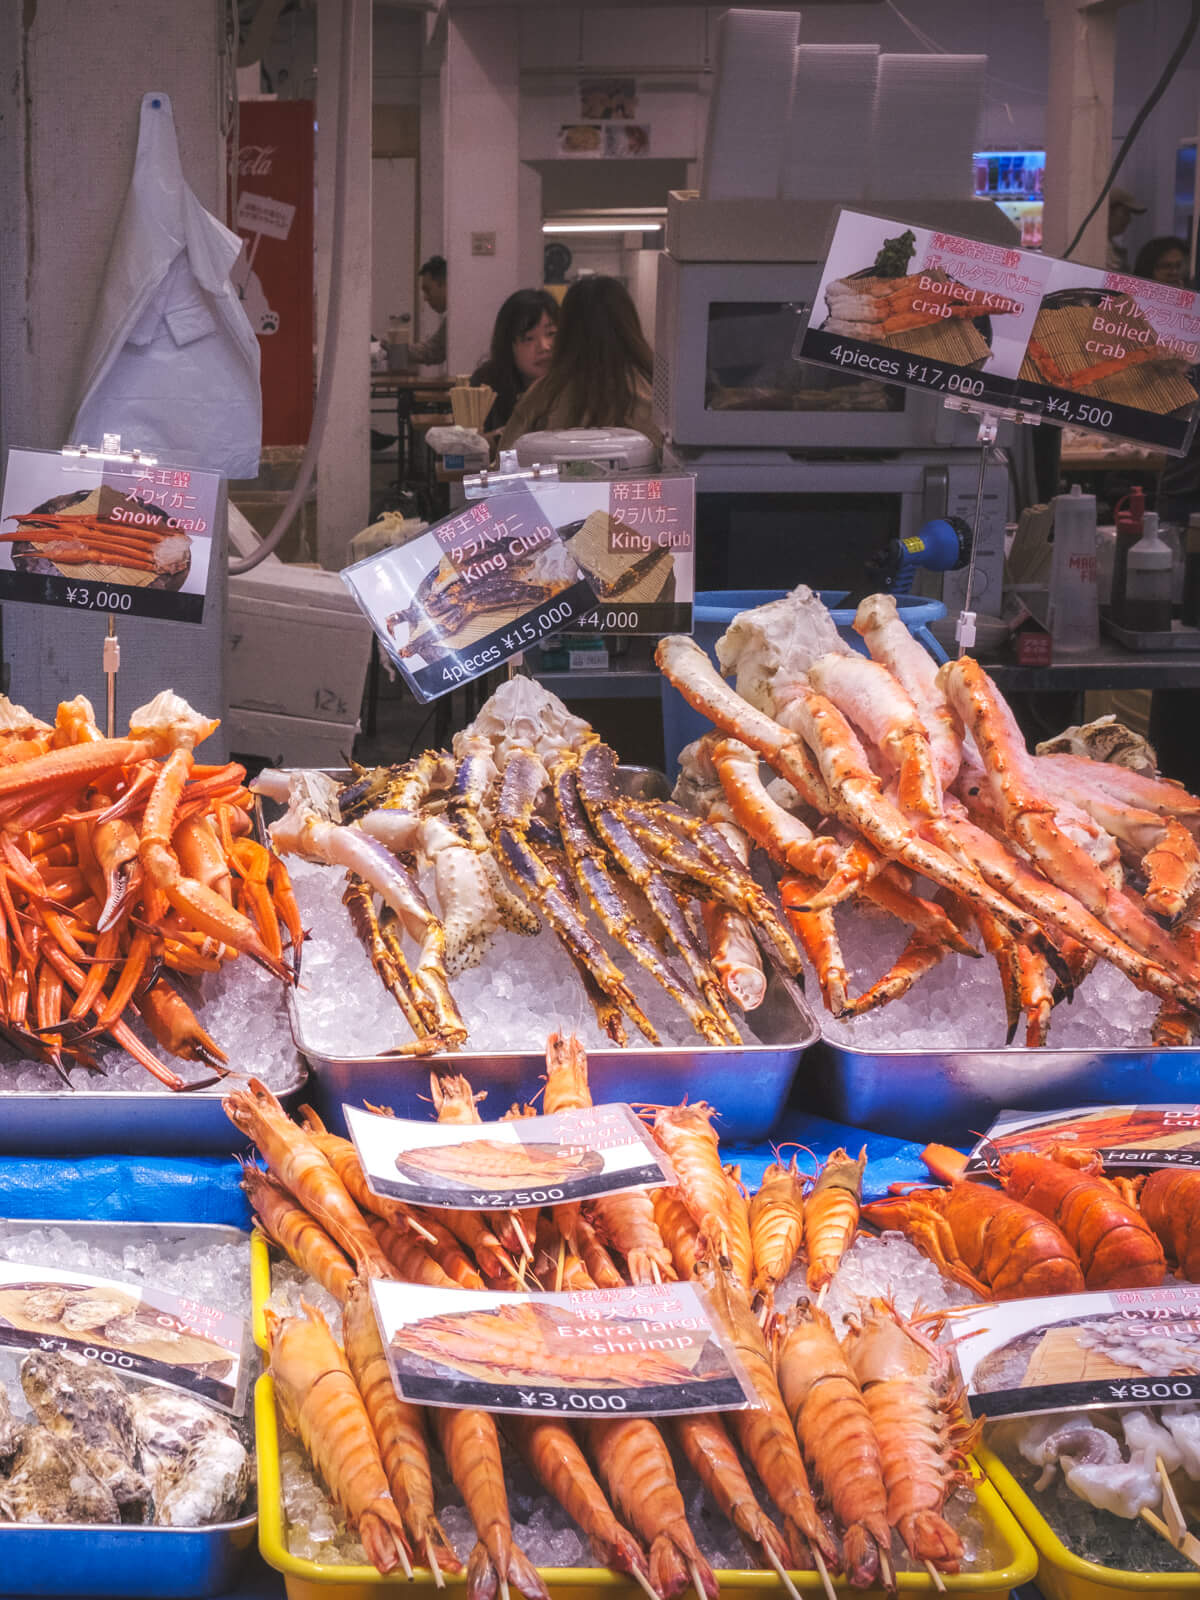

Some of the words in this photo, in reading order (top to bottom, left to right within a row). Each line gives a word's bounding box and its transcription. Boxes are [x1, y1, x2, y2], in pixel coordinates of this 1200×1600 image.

[919, 276, 977, 303] Boiled
[982, 292, 1024, 317] King
[912, 299, 953, 319] crab
[1092, 316, 1151, 344] Boiled
[1156, 334, 1197, 358] King
[1085, 340, 1126, 359] crab
[830, 344, 899, 375] 4pieces
[906, 361, 985, 397] ¥17,000
[1046, 395, 1113, 427] ¥4,500
[612, 480, 662, 500] 帝王蟹
[109, 506, 162, 526] Snow
[166, 513, 207, 533] crab
[436, 503, 492, 542] 帝王蟹
[612, 506, 678, 525] タラバガニ
[450, 513, 525, 564] タラバガニ
[612, 532, 652, 551] King
[657, 531, 690, 547] Club
[461, 554, 508, 586] King
[508, 524, 552, 557] Club
[66, 586, 132, 610] ¥3,000
[577, 611, 638, 631] ¥4,000
[441, 646, 502, 682] 4pieces
[500, 601, 573, 651] ¥15,000
[1108, 1152, 1158, 1160] Half
[471, 1188, 565, 1207] ¥2,500
[557, 1324, 632, 1338] Extra
[642, 1317, 711, 1333] large
[39, 1338, 133, 1367] ¥1000
[593, 1336, 693, 1353] shrimp
[519, 1391, 627, 1410] ¥3,000
[1108, 1383, 1192, 1399] ¥800
